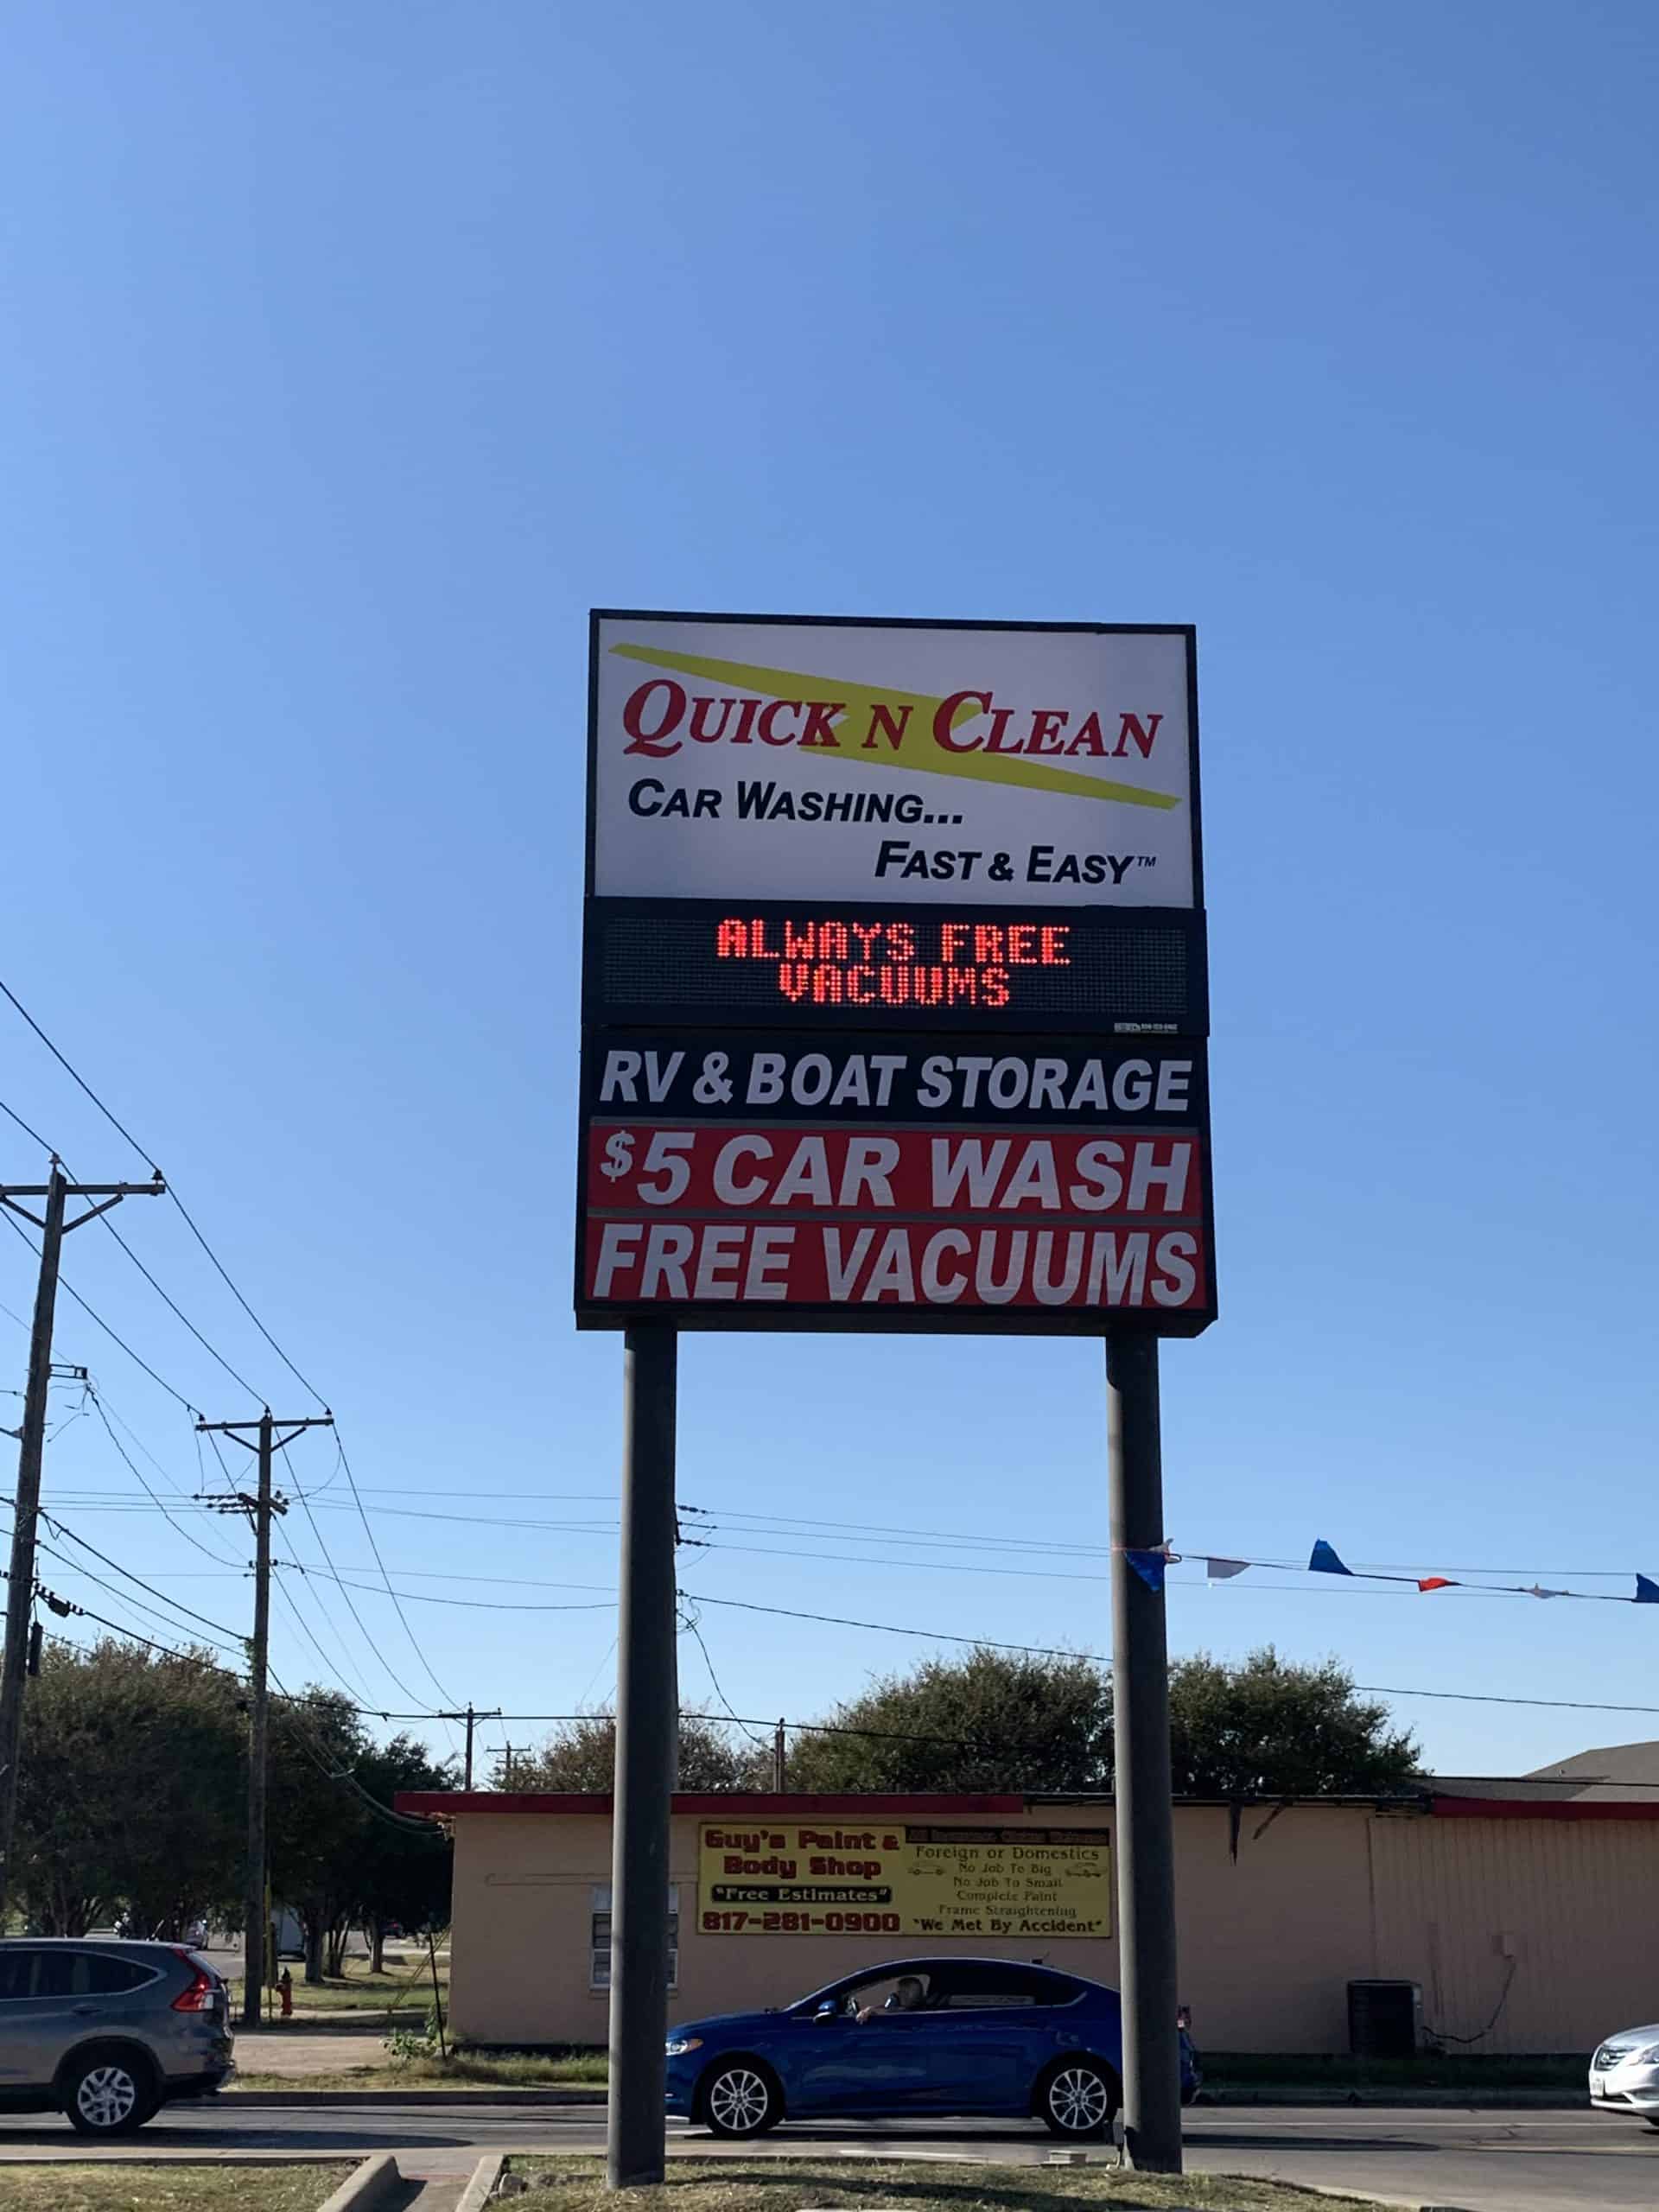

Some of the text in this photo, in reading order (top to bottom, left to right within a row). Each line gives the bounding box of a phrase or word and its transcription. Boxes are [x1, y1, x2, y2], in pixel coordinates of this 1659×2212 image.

[623, 679, 1163, 759] QUICK N CLEAN
[628, 778, 963, 823] CAR WASHING...
[874, 840, 982, 880] FAST
[988, 852, 1014, 882] &
[715, 918, 1071, 965] ALWAYS FREE
[778, 963, 1010, 1007] VACUUMS
[600, 1050, 1192, 1112] RV & BOAT STORAGE
[601, 1129, 1192, 1211] $5 CAR WASH
[593, 1223, 1198, 1306] FREE VACUUMS
[798, 1830, 876, 1850] Paint
[916, 1846, 1099, 1861] Foreign or Domestics
[723, 1855, 882, 1879] Body Shop
[951, 1918, 982, 1931] Met
[990, 1919, 1012, 1933] By
